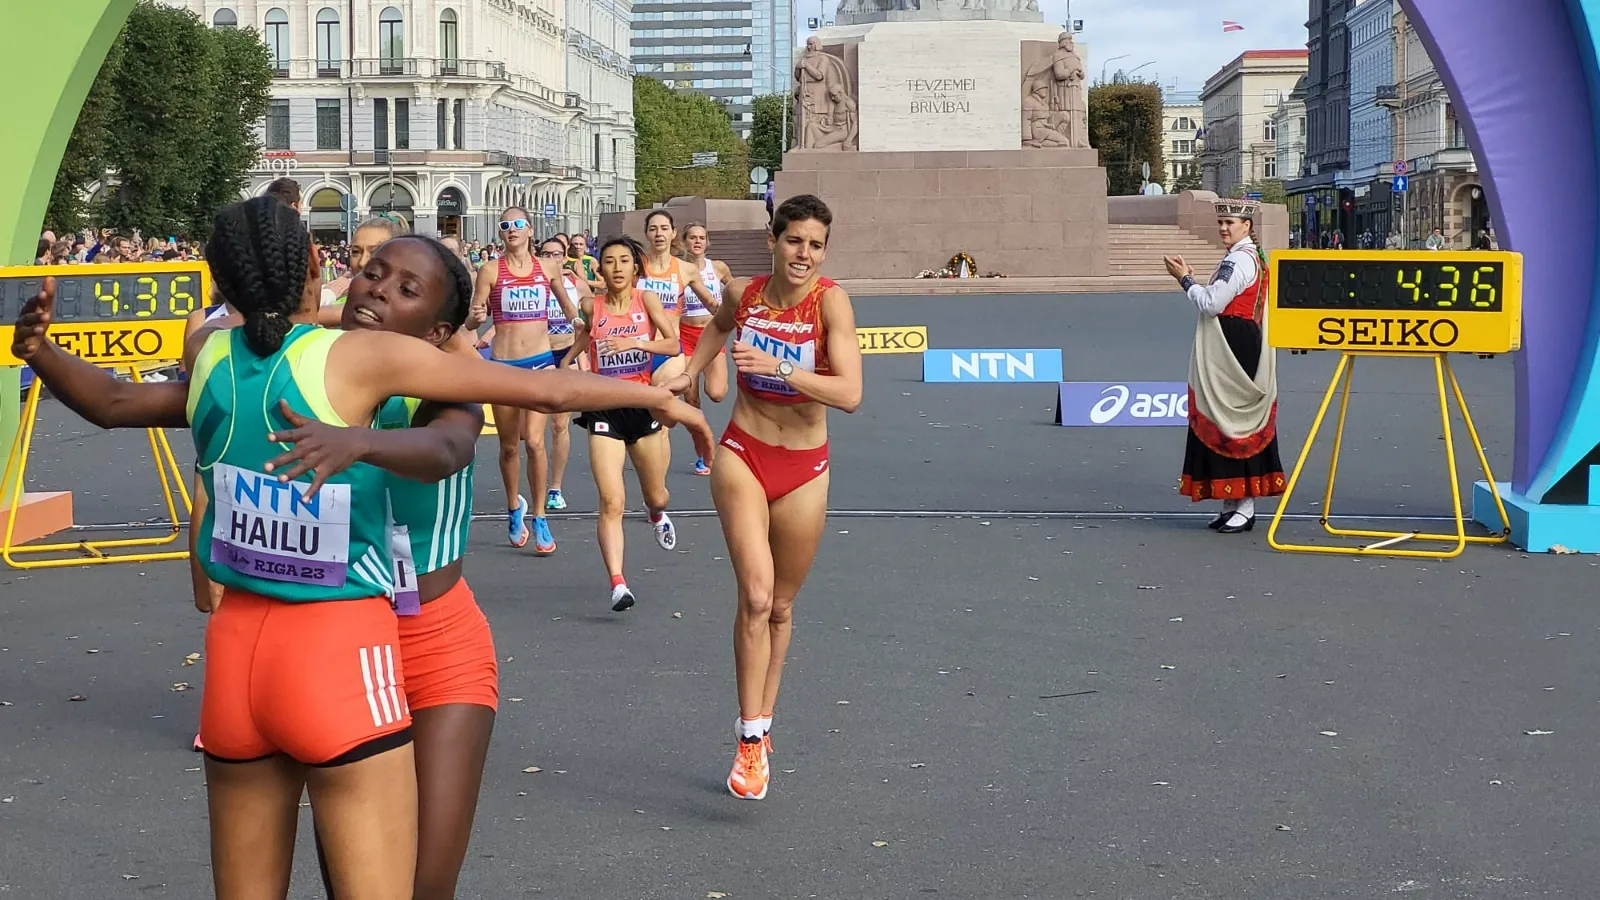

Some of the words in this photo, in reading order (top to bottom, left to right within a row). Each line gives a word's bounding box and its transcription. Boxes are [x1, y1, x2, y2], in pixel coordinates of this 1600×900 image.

[509, 288, 539, 299] NTN
[645, 281, 671, 291] NTN
[508, 300, 540, 311] WILEY
[606, 325, 638, 336] JAPAN
[745, 316, 814, 334] ESPAÑA
[1318, 318, 1459, 347] SEIKO
[51, 328, 163, 358] EIKO
[752, 334, 801, 362] NTN
[856, 331, 925, 349] EIKO
[600, 351, 648, 367] TANAKA
[951, 352, 1035, 379] NTN
[1130, 393, 1189, 418] asic
[234, 471, 321, 520] NTN
[230, 510, 320, 556] HAILU
[254, 559, 298, 577] RIGA
[301, 567, 325, 580] 23
